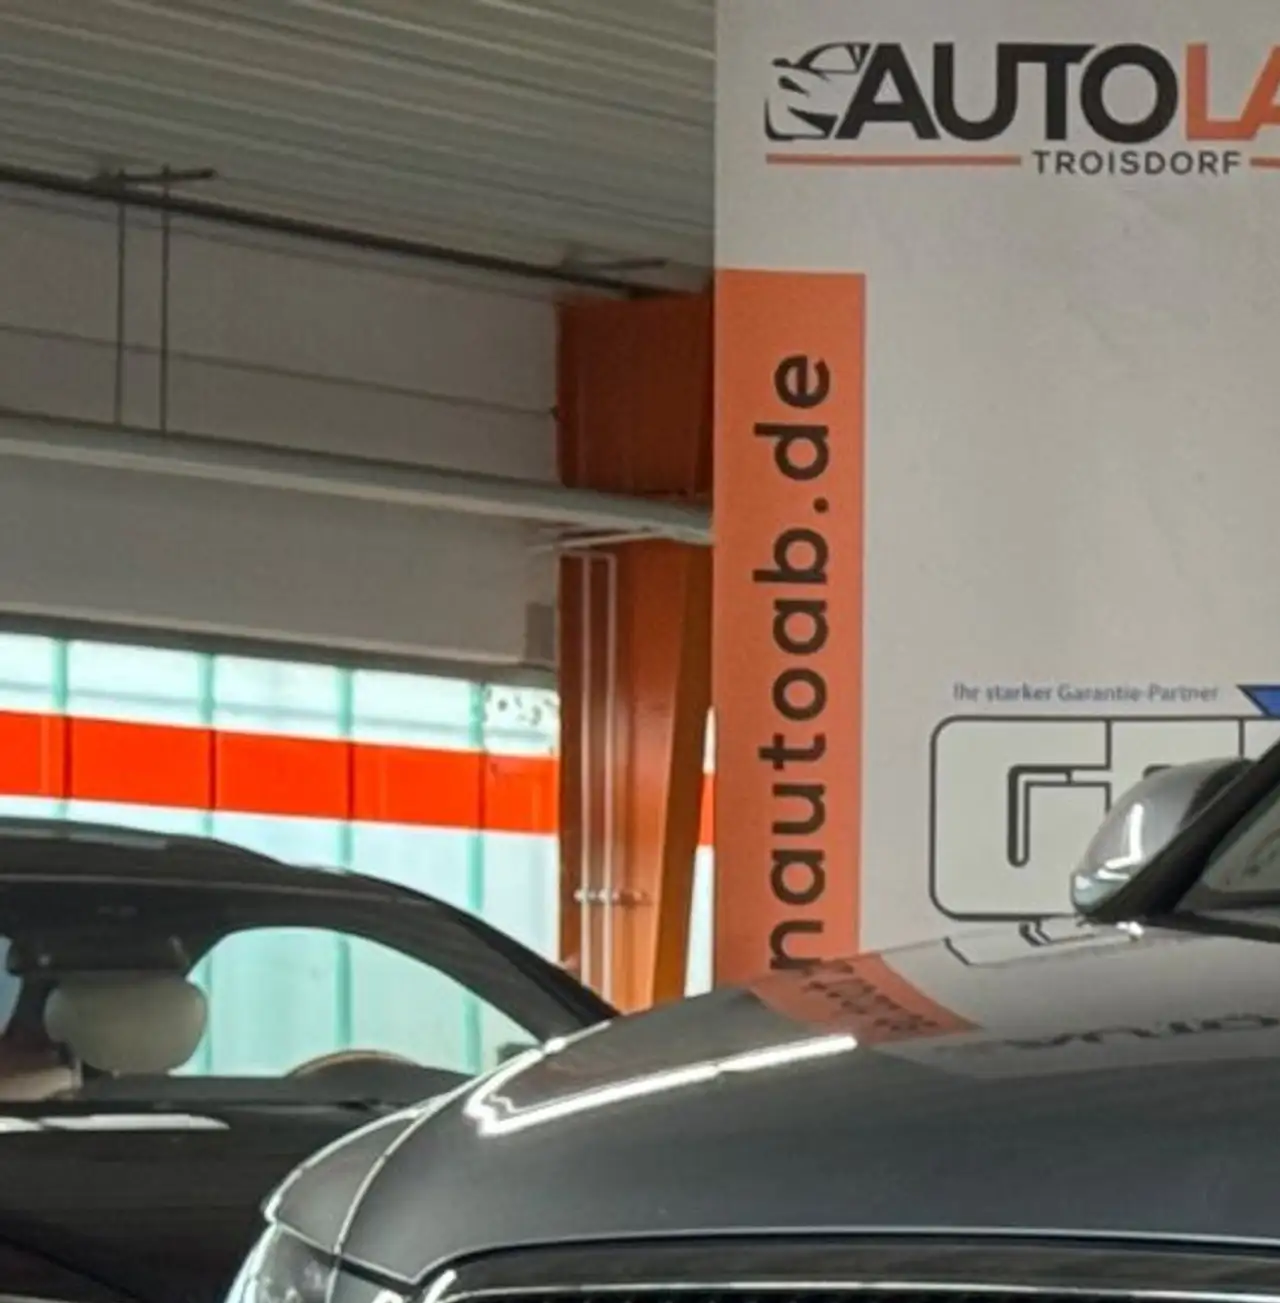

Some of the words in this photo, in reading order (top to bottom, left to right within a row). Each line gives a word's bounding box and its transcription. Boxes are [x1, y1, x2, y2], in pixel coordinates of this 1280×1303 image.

[1032, 149, 1241, 176] TROISDORF
[952, 683, 980, 703] Ihr
[985, 683, 1052, 703] starker
[1056, 683, 1219, 704] Garantie-Partner
